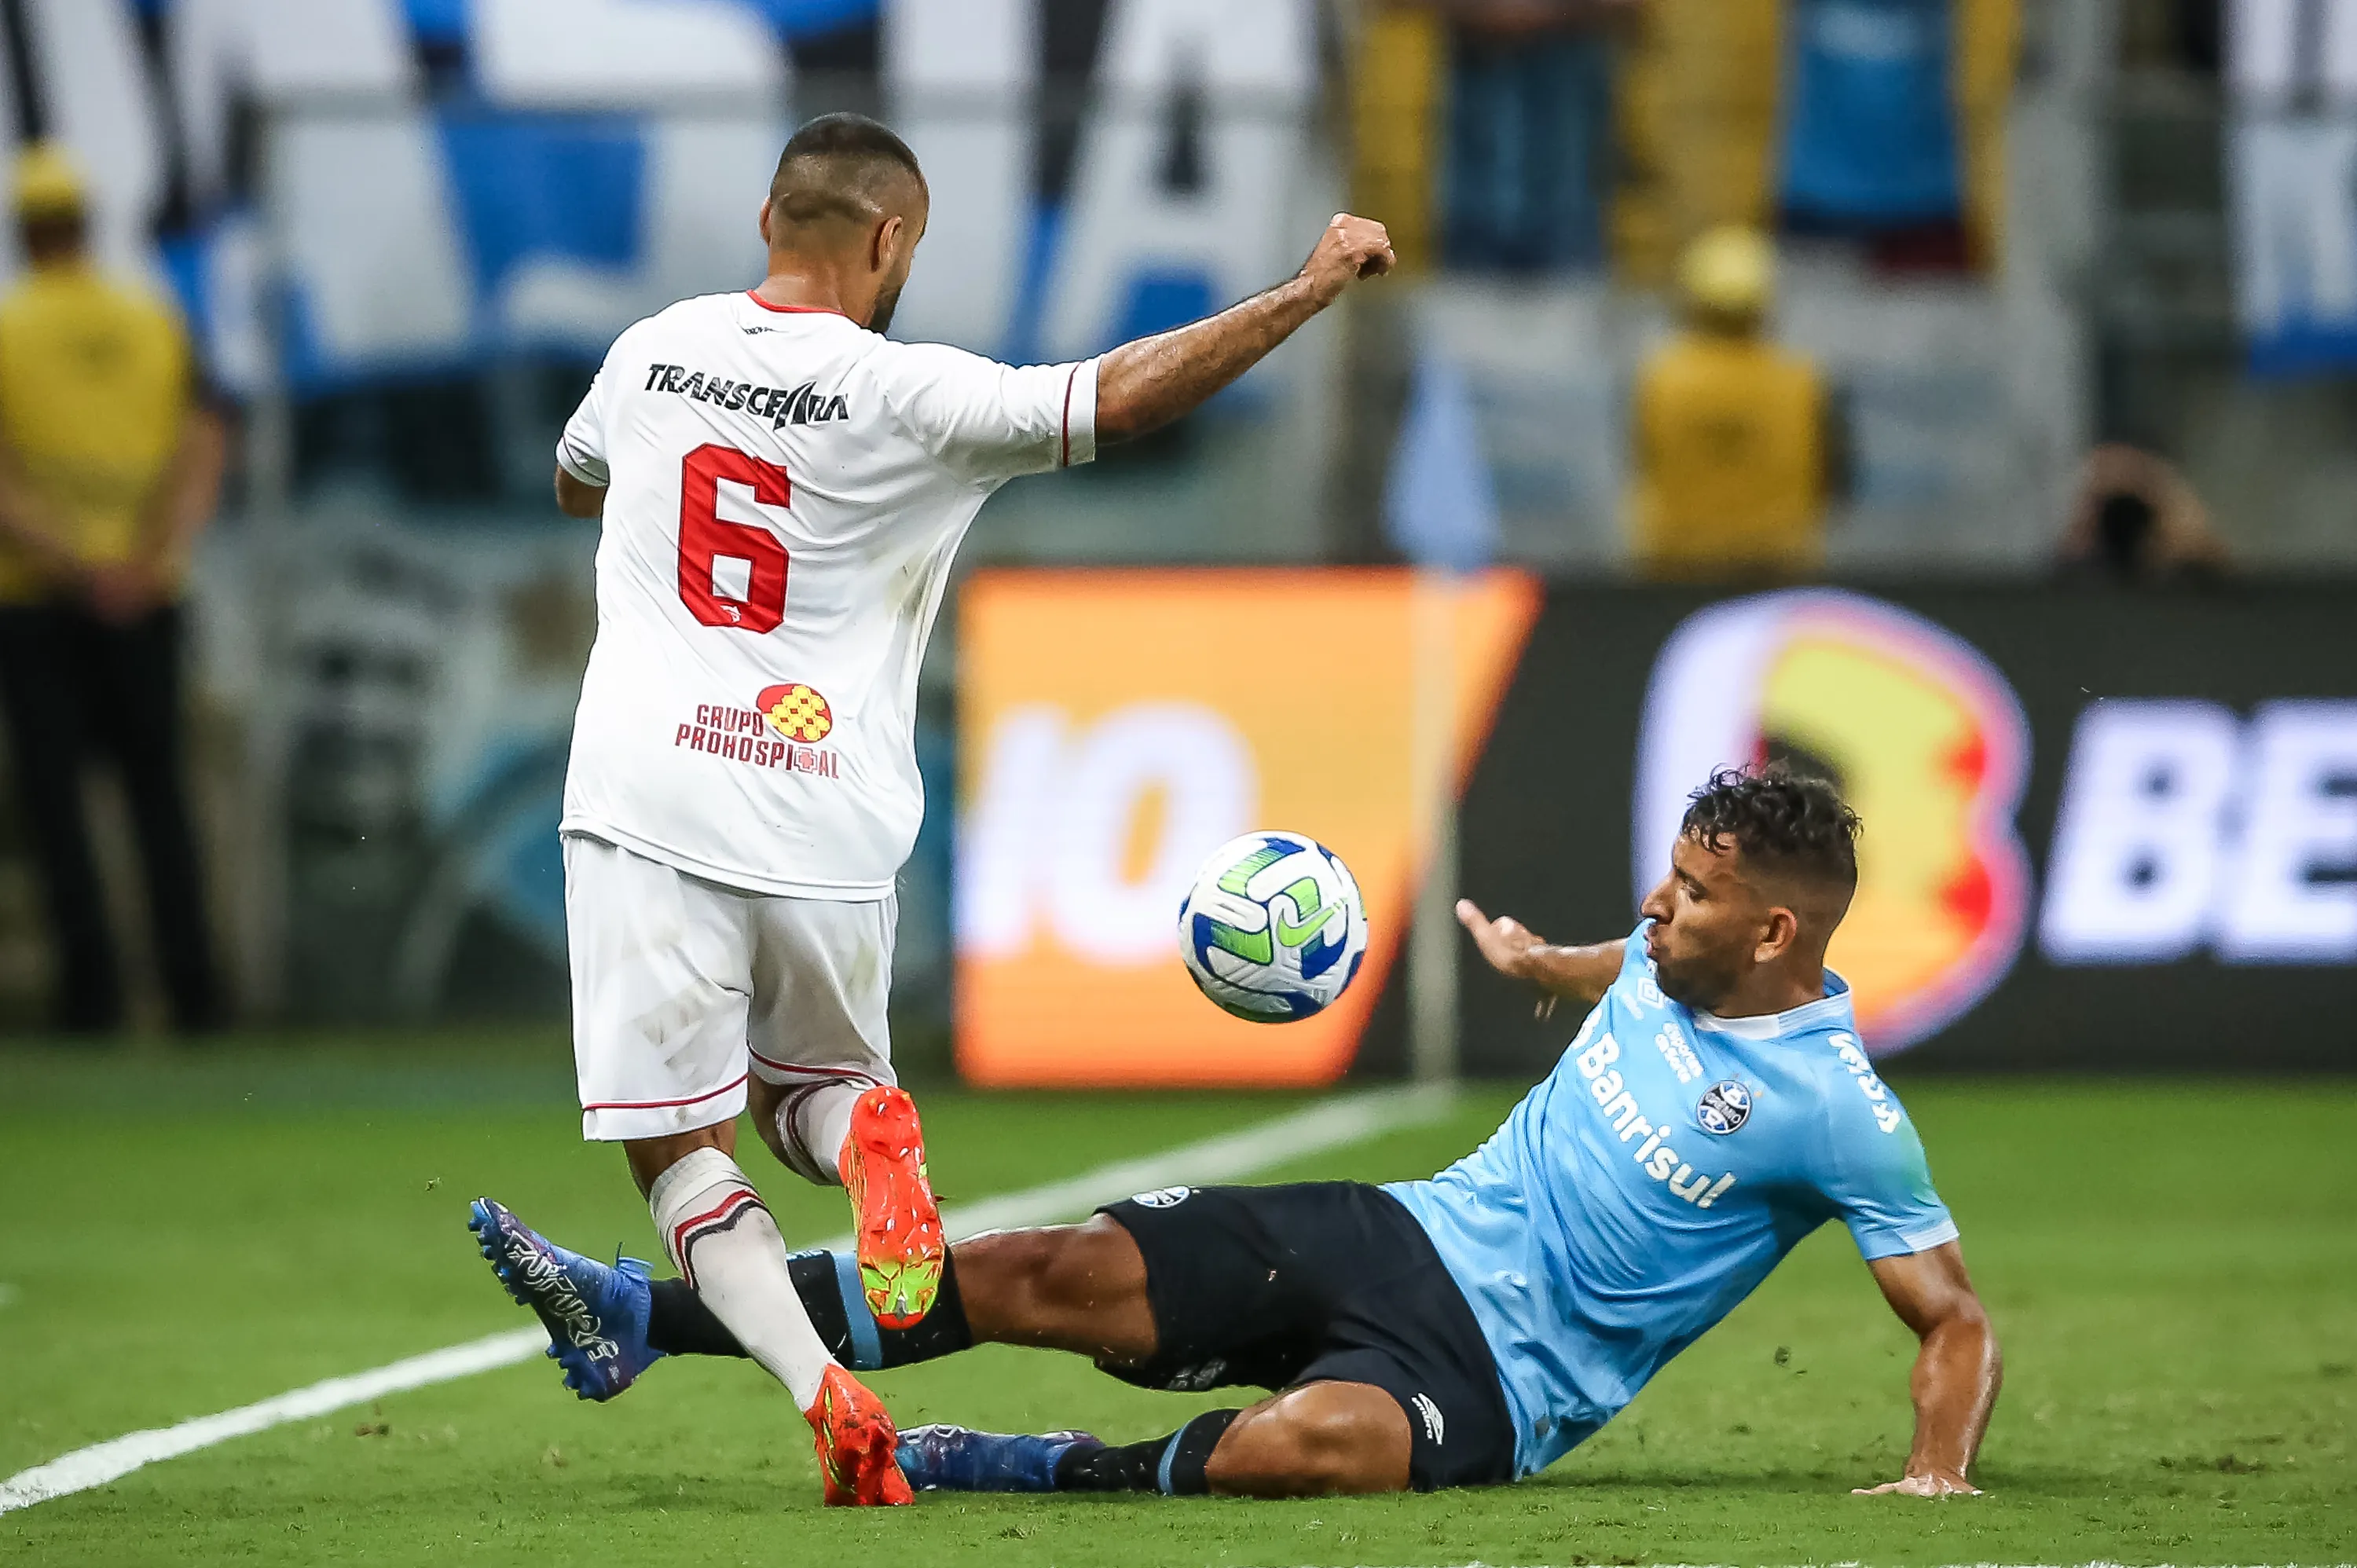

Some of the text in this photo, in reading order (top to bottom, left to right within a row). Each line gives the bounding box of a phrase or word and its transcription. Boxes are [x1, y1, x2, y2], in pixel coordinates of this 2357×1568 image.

[677, 441, 793, 635] 6
[696, 704, 764, 737] GRUPO
[1575, 1031, 1737, 1209] Banrisul
